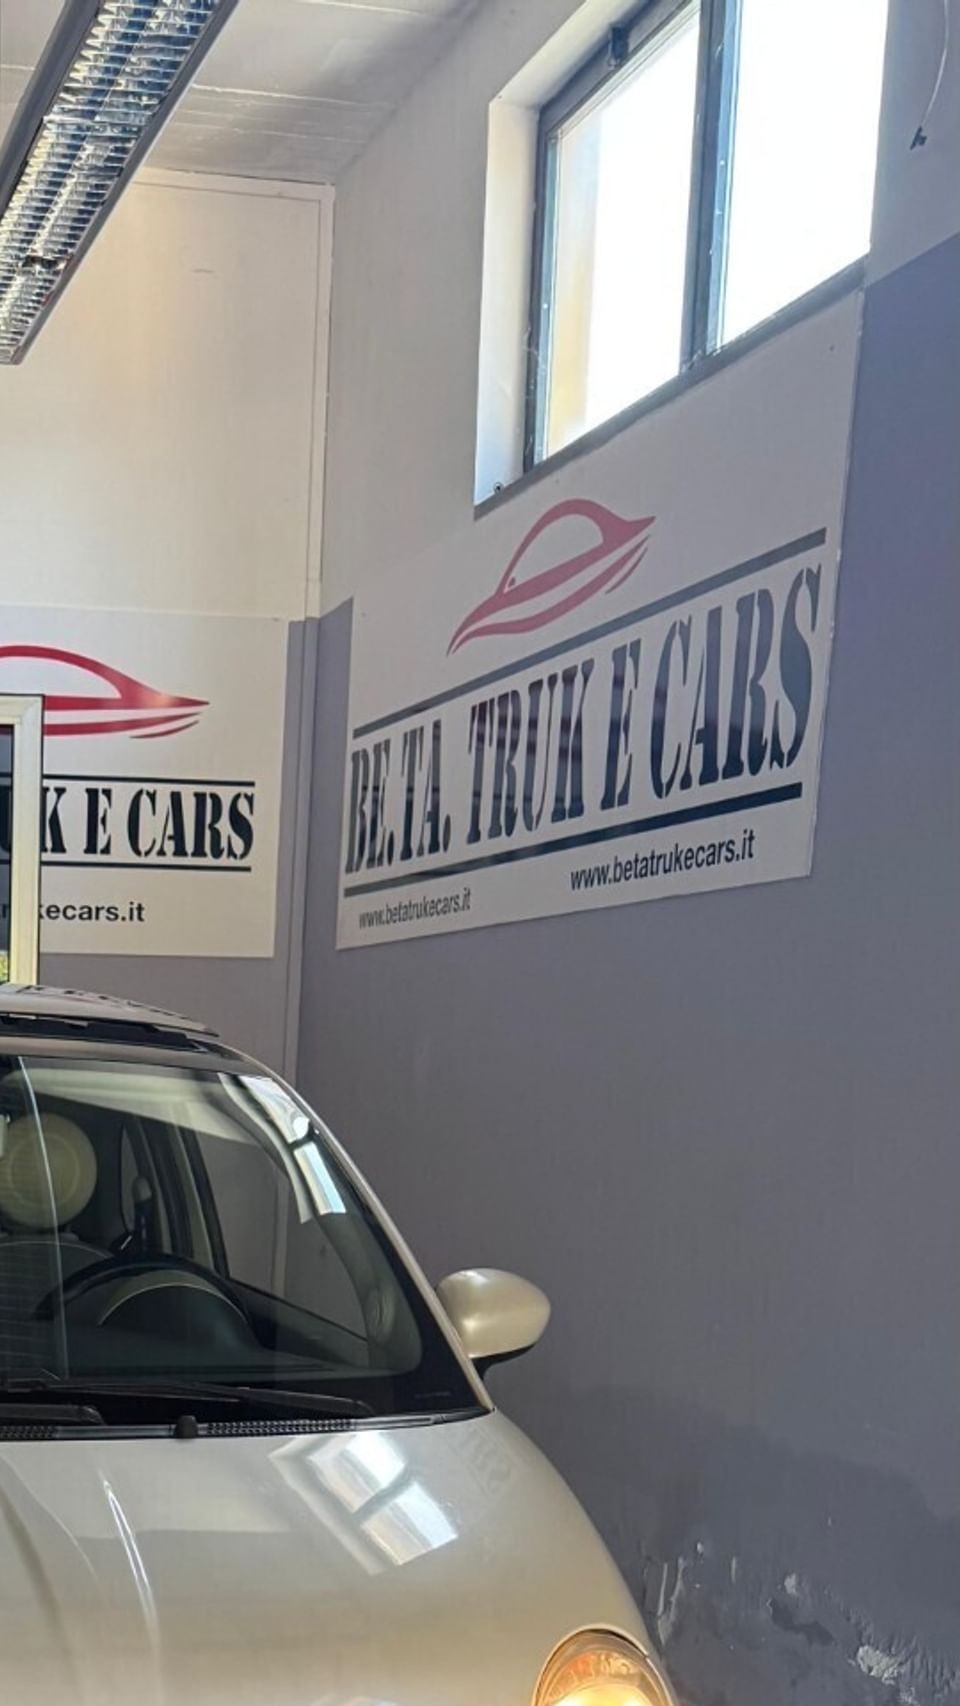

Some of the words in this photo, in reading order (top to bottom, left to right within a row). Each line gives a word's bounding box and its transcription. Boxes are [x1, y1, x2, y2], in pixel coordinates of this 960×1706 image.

[345, 719, 451, 874] BE.TA.
[466, 657, 596, 844] TRUK
[600, 638, 642, 811] E
[650, 563, 822, 799] CARS
[83, 788, 112, 855] E
[128, 788, 255, 860] CARS
[570, 829, 755, 891] www.betatrukecars.it
